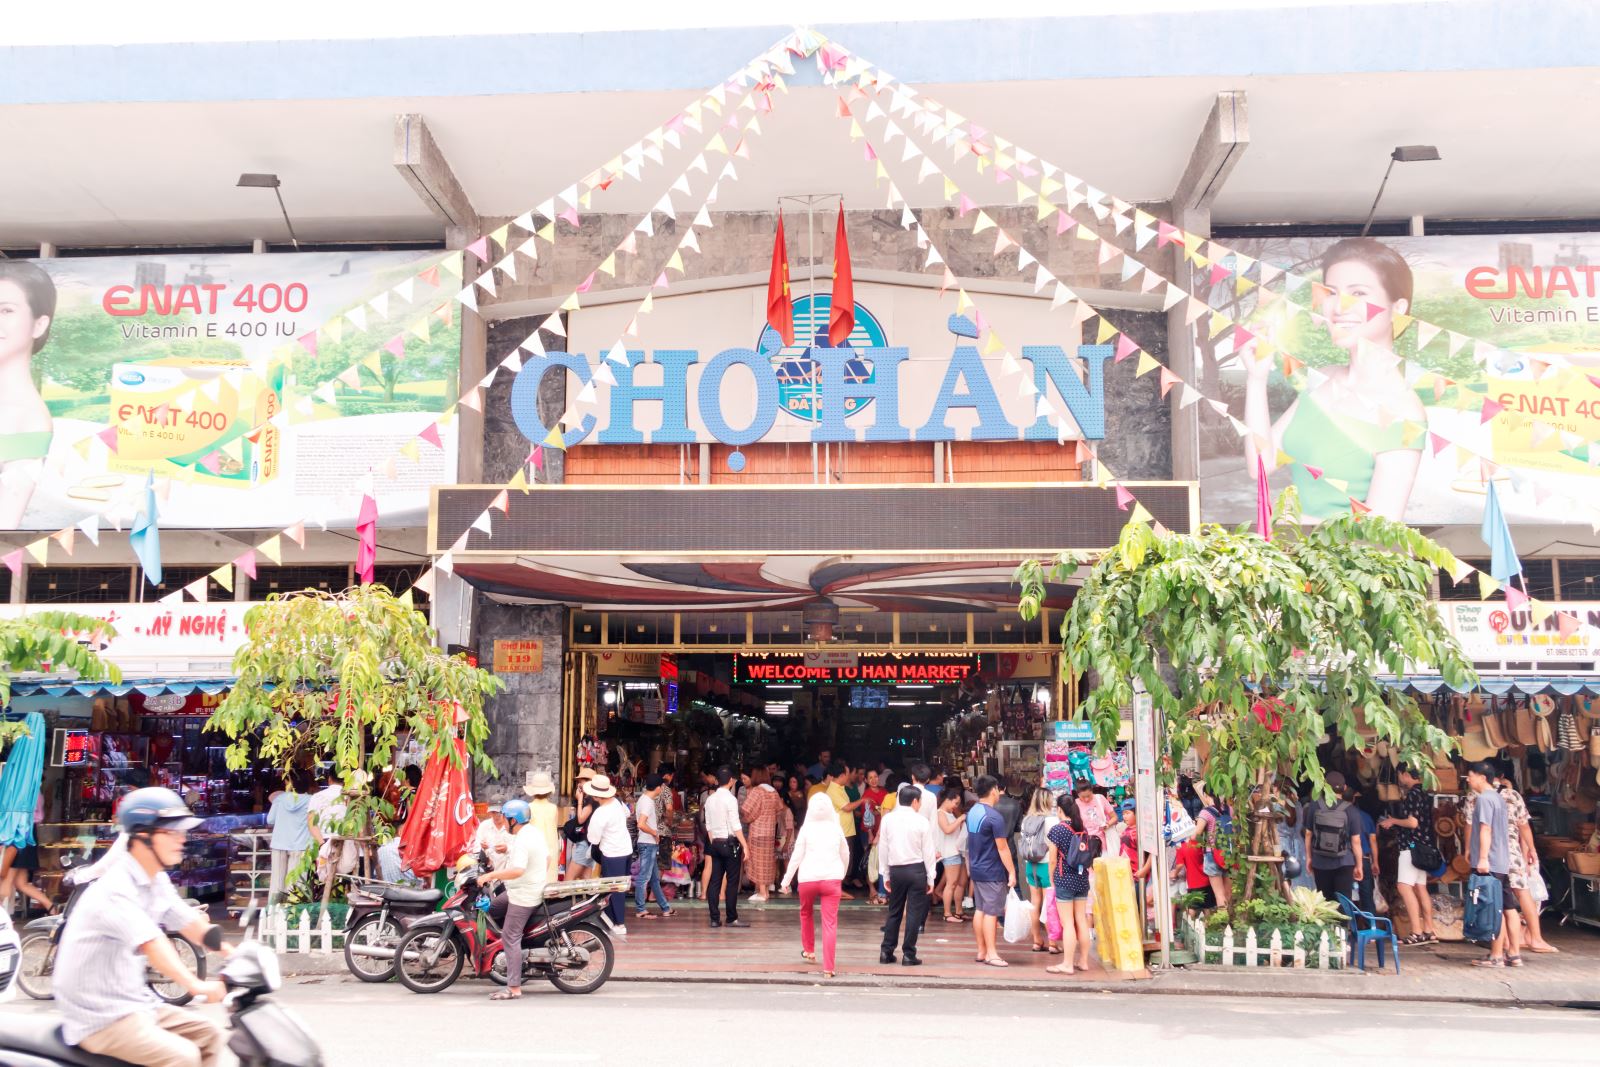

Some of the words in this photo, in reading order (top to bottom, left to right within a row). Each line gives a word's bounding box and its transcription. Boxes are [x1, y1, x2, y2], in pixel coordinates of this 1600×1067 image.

[102, 283, 226, 317] ENAT
[233, 282, 309, 314] 400
[1490, 307, 1577, 323] Vitamin
[1587, 308, 1598, 322] E
[121, 322, 199, 339] Vitamin
[206, 322, 217, 337] E
[226, 322, 268, 338] 400
[275, 321, 297, 337] IU
[510, 329, 782, 474] CHỢ
[810, 313, 1115, 443] HÀN
[186, 411, 227, 431] 400
[157, 431, 175, 440] 400
[177, 432, 186, 441] IU
[747, 665, 831, 679] WELCOME
[836, 668, 858, 679] TO
[863, 665, 898, 679] HAN
[902, 665, 971, 679] MARKET
